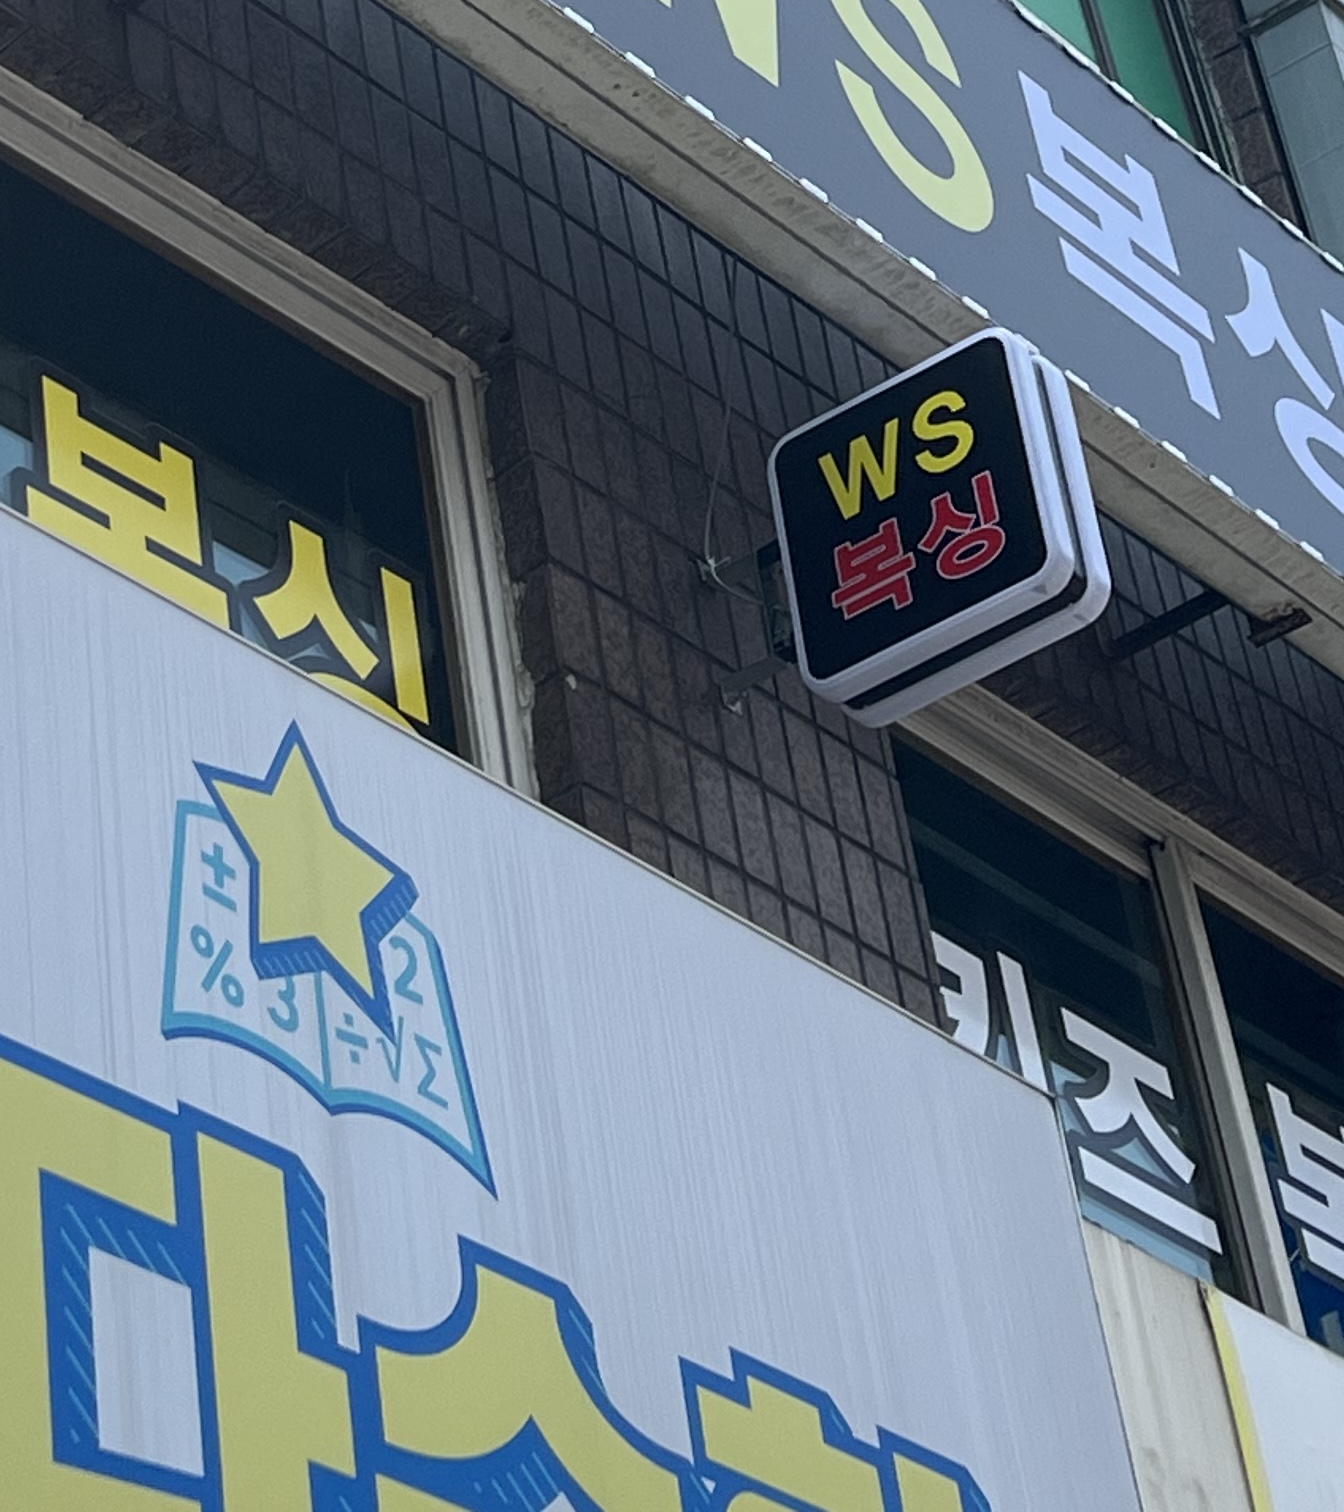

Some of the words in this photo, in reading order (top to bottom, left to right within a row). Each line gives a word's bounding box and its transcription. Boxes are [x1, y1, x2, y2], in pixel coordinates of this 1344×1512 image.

[818, 390, 974, 520] WS
[831, 470, 1006, 620] 복싱
[931, 930, 1223, 1255] 키즈
